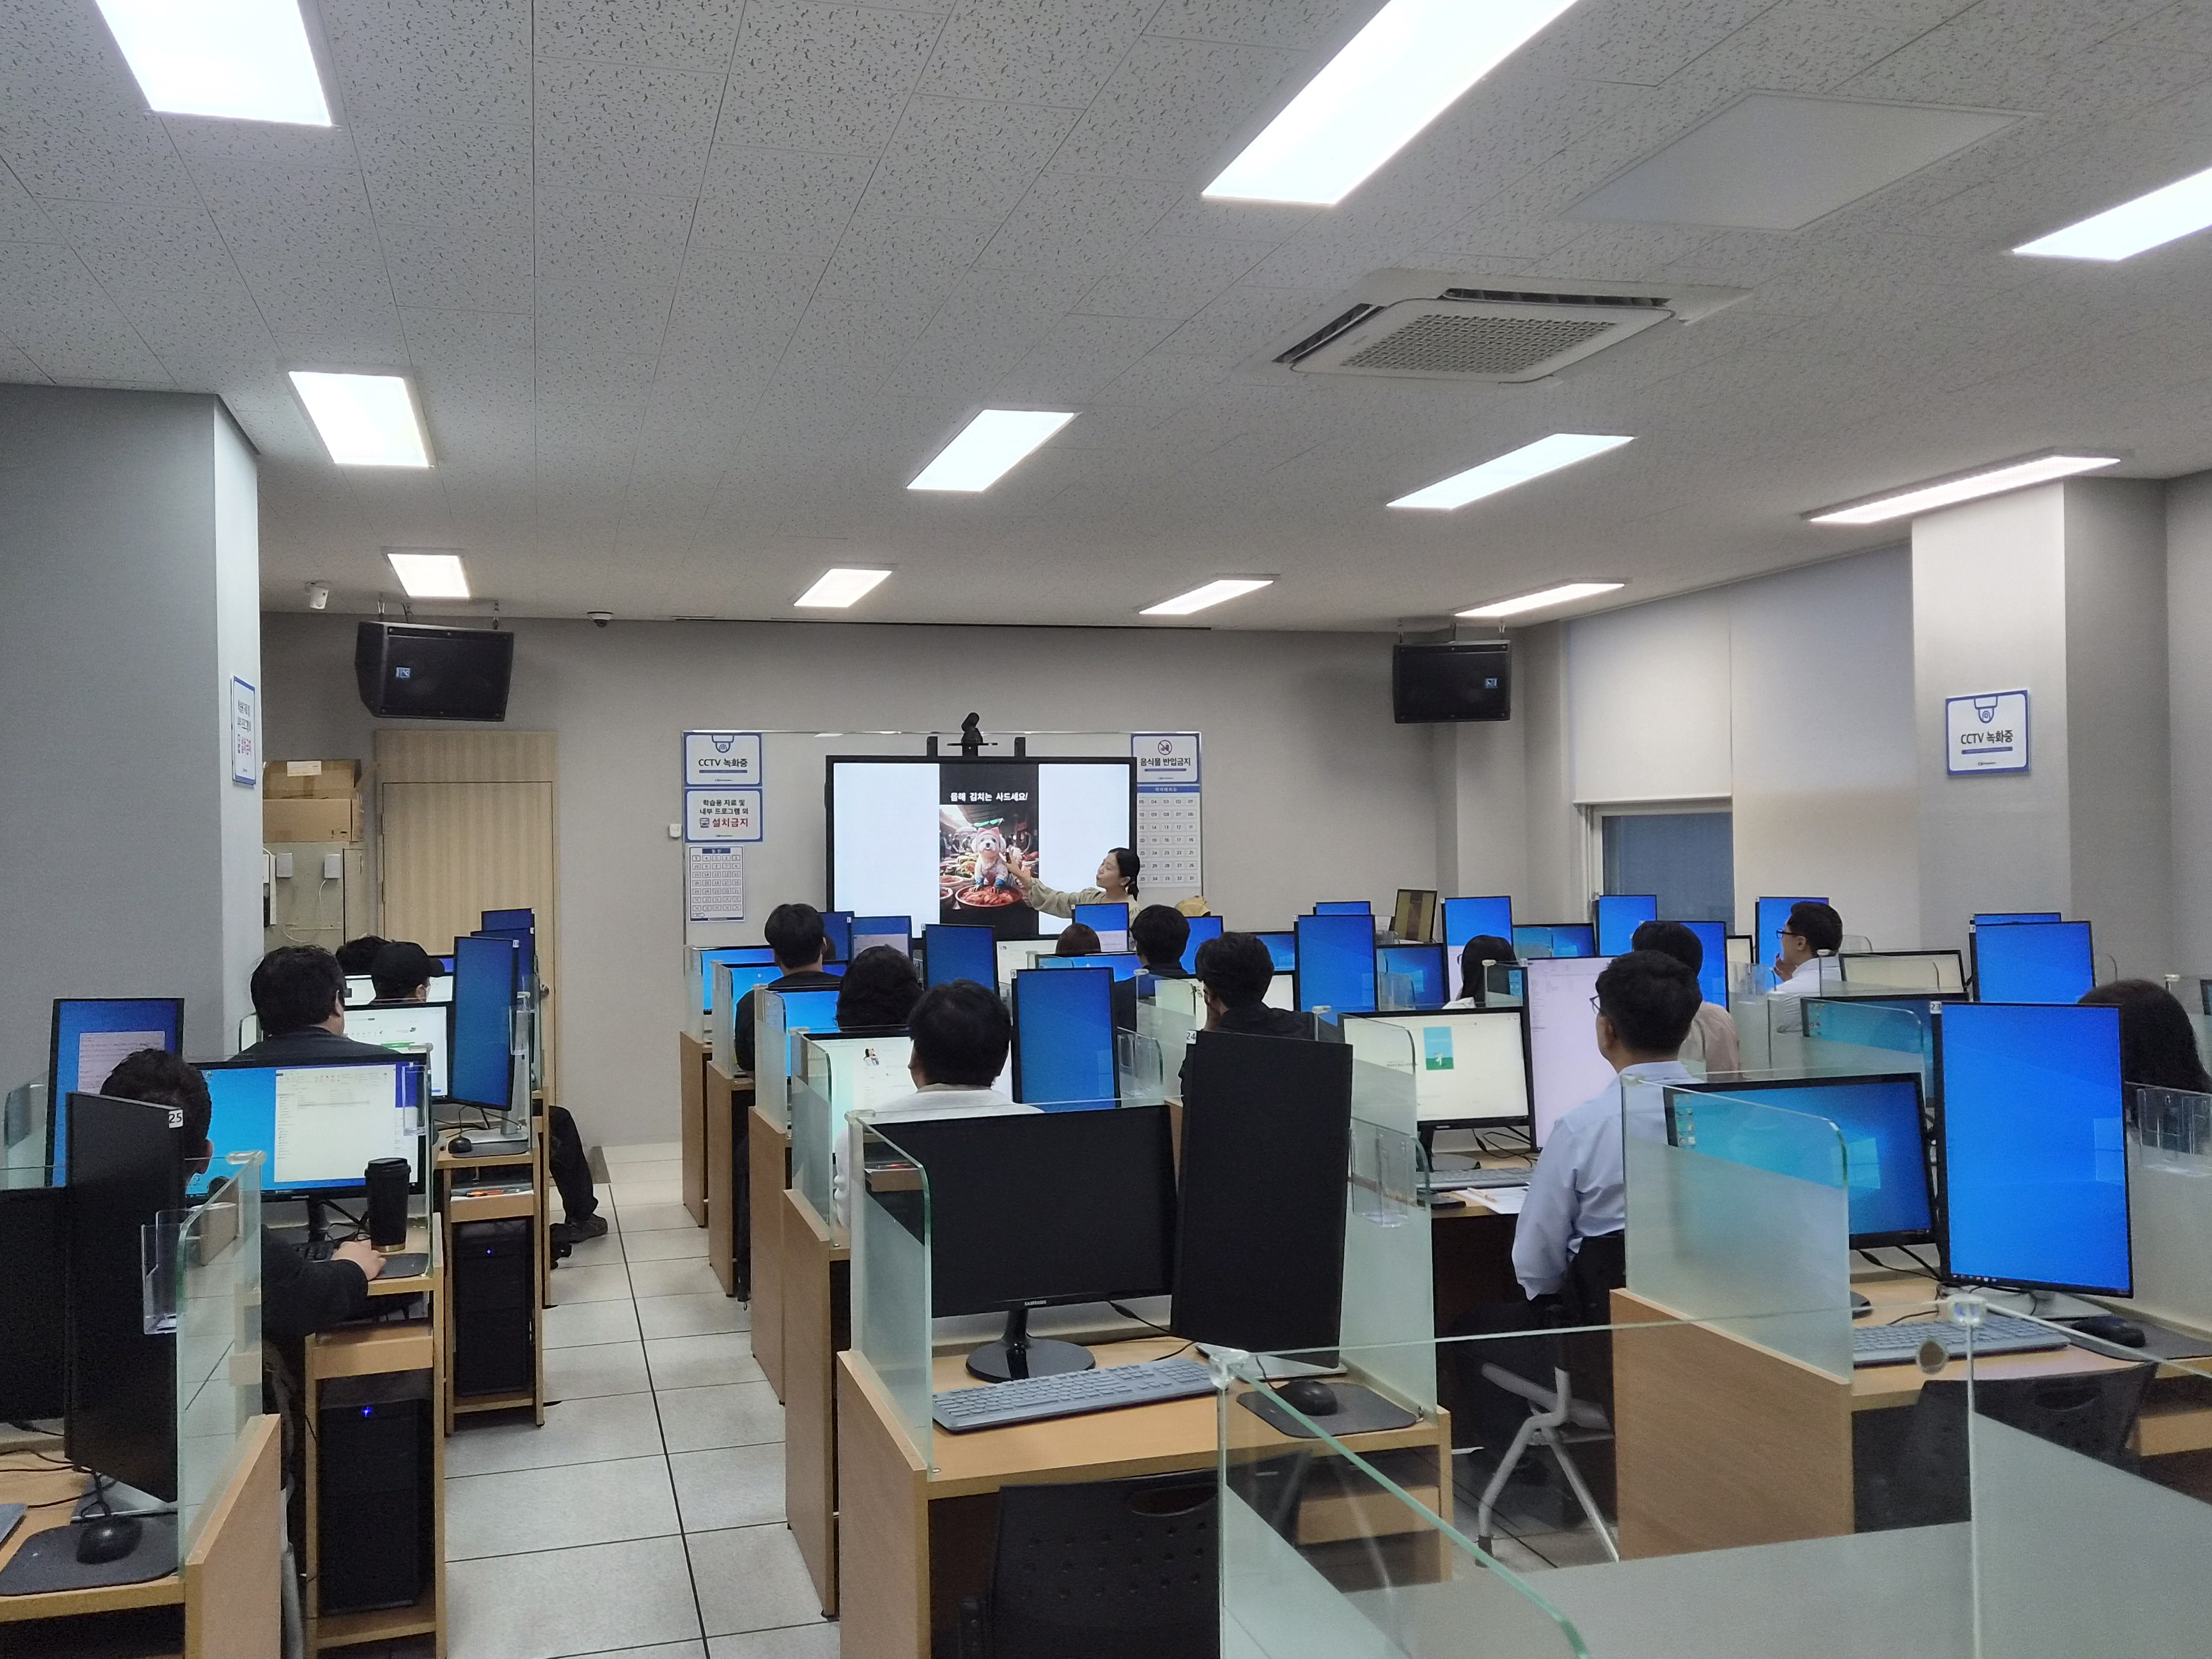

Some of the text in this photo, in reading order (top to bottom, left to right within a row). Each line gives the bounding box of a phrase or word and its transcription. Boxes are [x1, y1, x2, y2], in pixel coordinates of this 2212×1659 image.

[1961, 729, 2013, 744] CCTV 녹화중
[723, 758, 748, 767] 녹화중
[1140, 757, 1191, 766] 음식물 반입금지
[951, 792, 1028, 801] 올해 김치는 사드세요!
[712, 818, 748, 827] 설치금지
[1186, 1032, 1196, 1040] 24
[169, 1112, 182, 1123] 25
